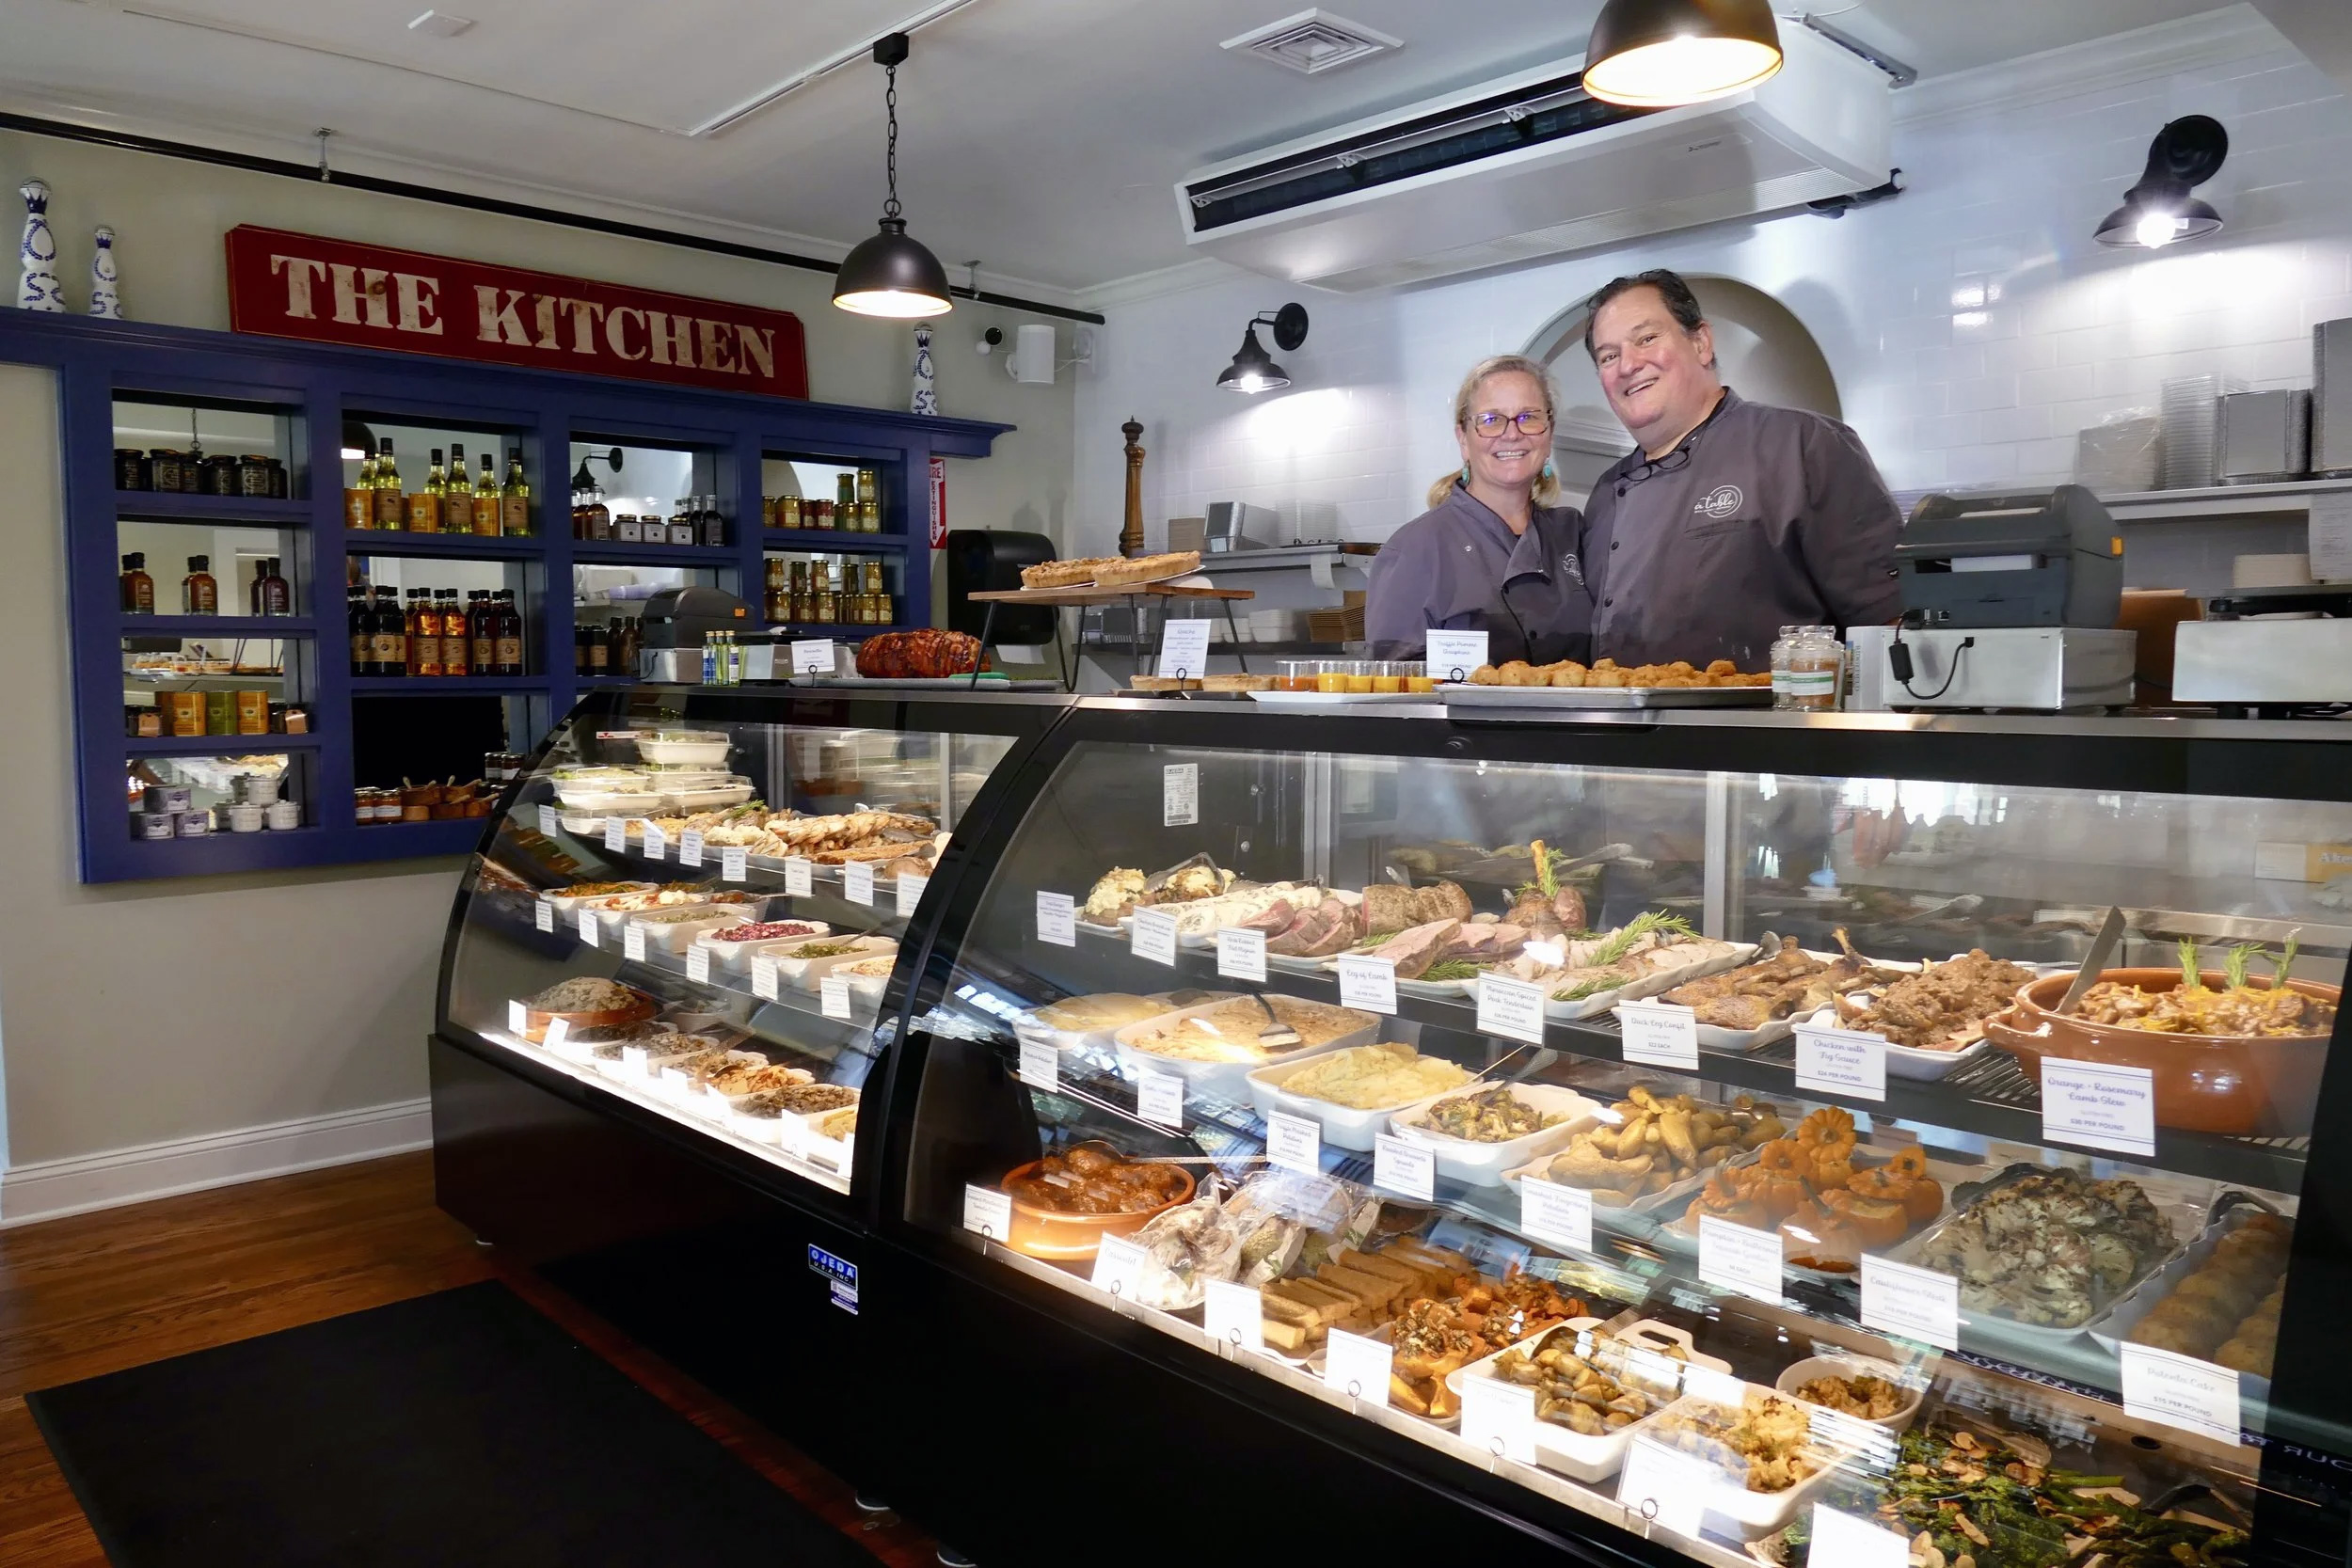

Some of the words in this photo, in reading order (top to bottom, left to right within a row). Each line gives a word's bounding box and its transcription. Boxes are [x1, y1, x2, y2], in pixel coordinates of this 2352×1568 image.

[271, 254, 443, 335] THE
[473, 284, 775, 378] KITCHEN
[1700, 492, 1736, 509] table
[1368, 972, 1389, 980] Lamb
[1631, 1017, 1648, 1026] Duck
[1664, 1021, 1686, 1030] Confit
[1814, 1038, 1845, 1051] Chicken
[1847, 1045, 1867, 1054] with
[1819, 1052, 1834, 1063] Fig
[1835, 1054, 1861, 1065] Sauce
[2047, 1077, 2085, 1091] Orange
[2093, 1083, 2146, 1100] Rosemary
[2068, 1091, 2098, 1103] Lamb
[2100, 1096, 2126, 1107] Stew
[2098, 1122, 2125, 1132] POUND
[811, 1249, 854, 1278] OJEDA
[836, 1273, 852, 1284] INC.
[1869, 1275, 1919, 1297] Cauliflower
[2147, 1367, 2187, 1385] Polenta
[2168, 1399, 2183, 1408] PER
[2184, 1402, 2213, 1418] POUND
